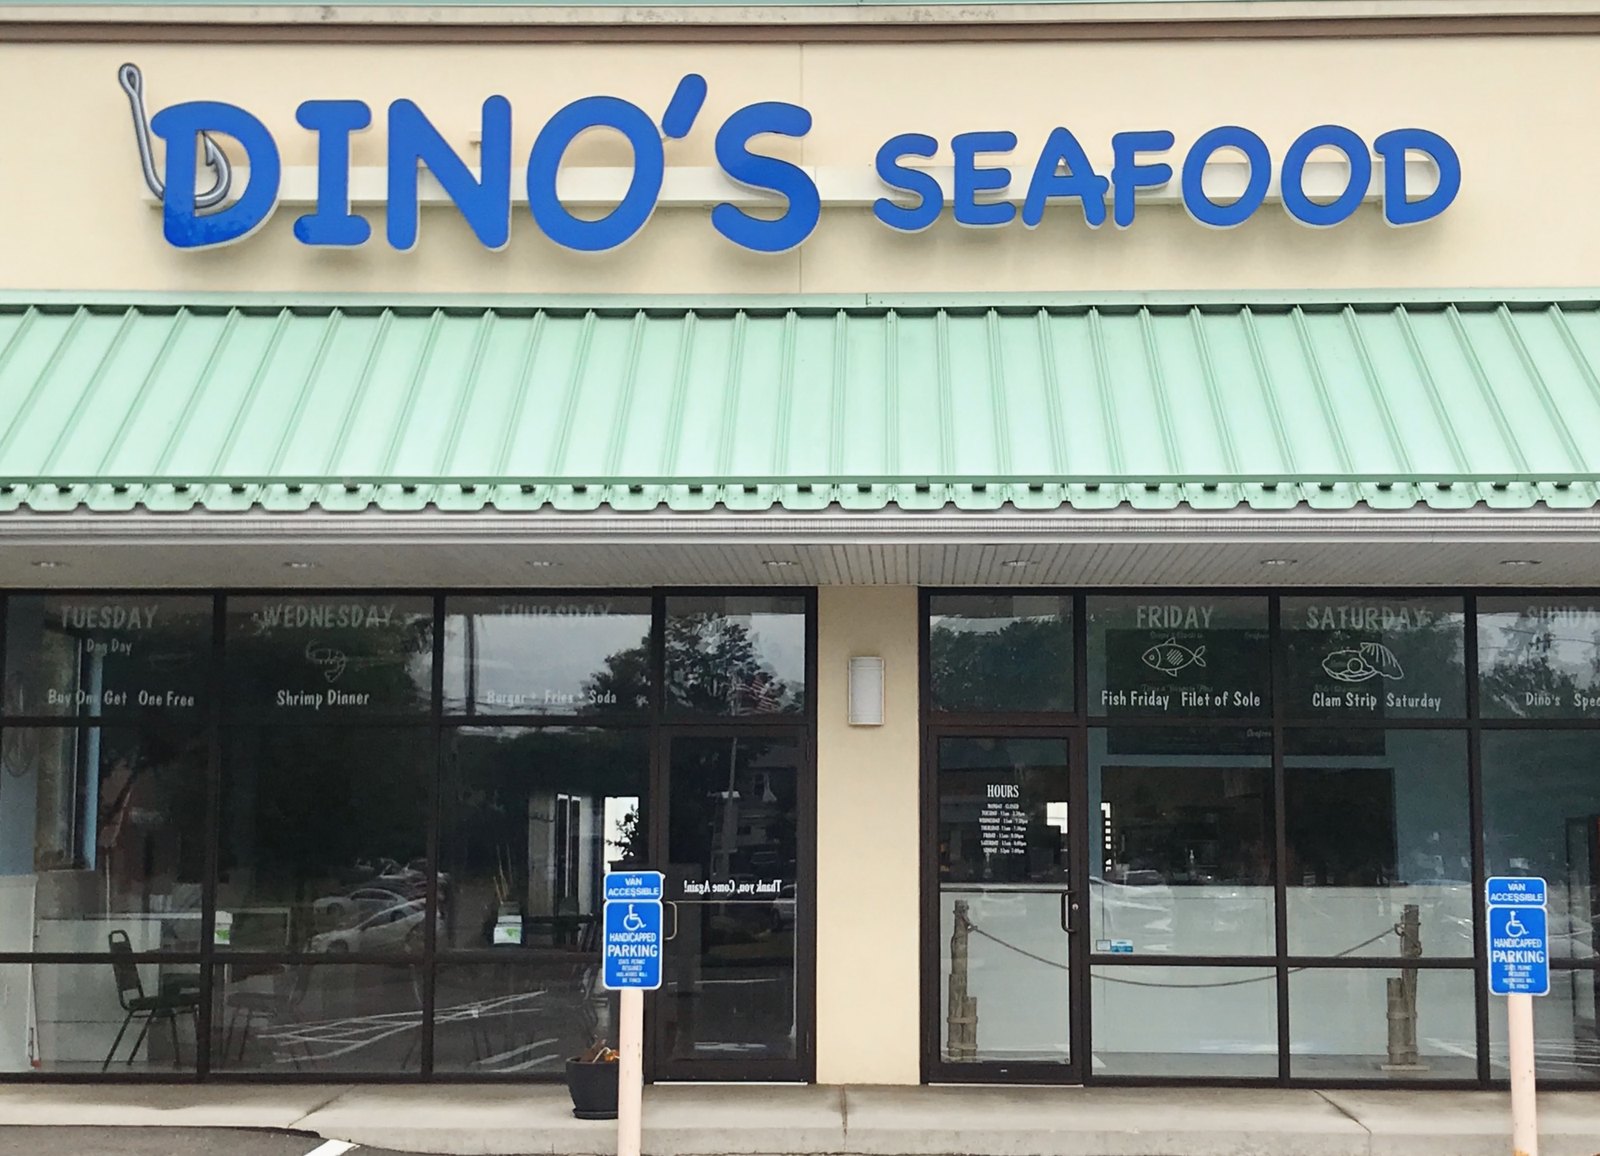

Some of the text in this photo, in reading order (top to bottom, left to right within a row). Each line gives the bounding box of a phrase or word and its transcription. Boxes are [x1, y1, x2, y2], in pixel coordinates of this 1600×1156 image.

[150, 73, 1461, 254] DINO'S SEAFOOD
[61, 605, 159, 629] TUESDAY
[264, 604, 396, 628] WEDNESDAY
[1137, 605, 1214, 629] FRIDAY
[1306, 606, 1426, 630] SATURDAY
[112, 638, 132, 656] Day
[47, 689, 195, 707] Buy On Get One Free
[276, 689, 371, 710] Shrimp Dinner
[486, 690, 526, 707] Burger
[545, 690, 575, 704] Fries
[589, 689, 617, 704] Soda
[1101, 690, 1261, 711] Fish Friday Filet of Sole
[1312, 692, 1442, 711] Clam Strip Saturday
[1525, 691, 1561, 706] Dino's
[987, 784, 1019, 798] HOURS
[608, 887, 659, 896] ACCESSIBLE
[1507, 883, 1525, 891] VAN
[1490, 893, 1543, 902] ACCESSIBLE
[609, 932, 656, 942] HANDICAPPED
[1493, 938, 1542, 948] HANDICAPPED
[607, 945, 658, 957] PARKING
[1492, 951, 1544, 963] PARKING
